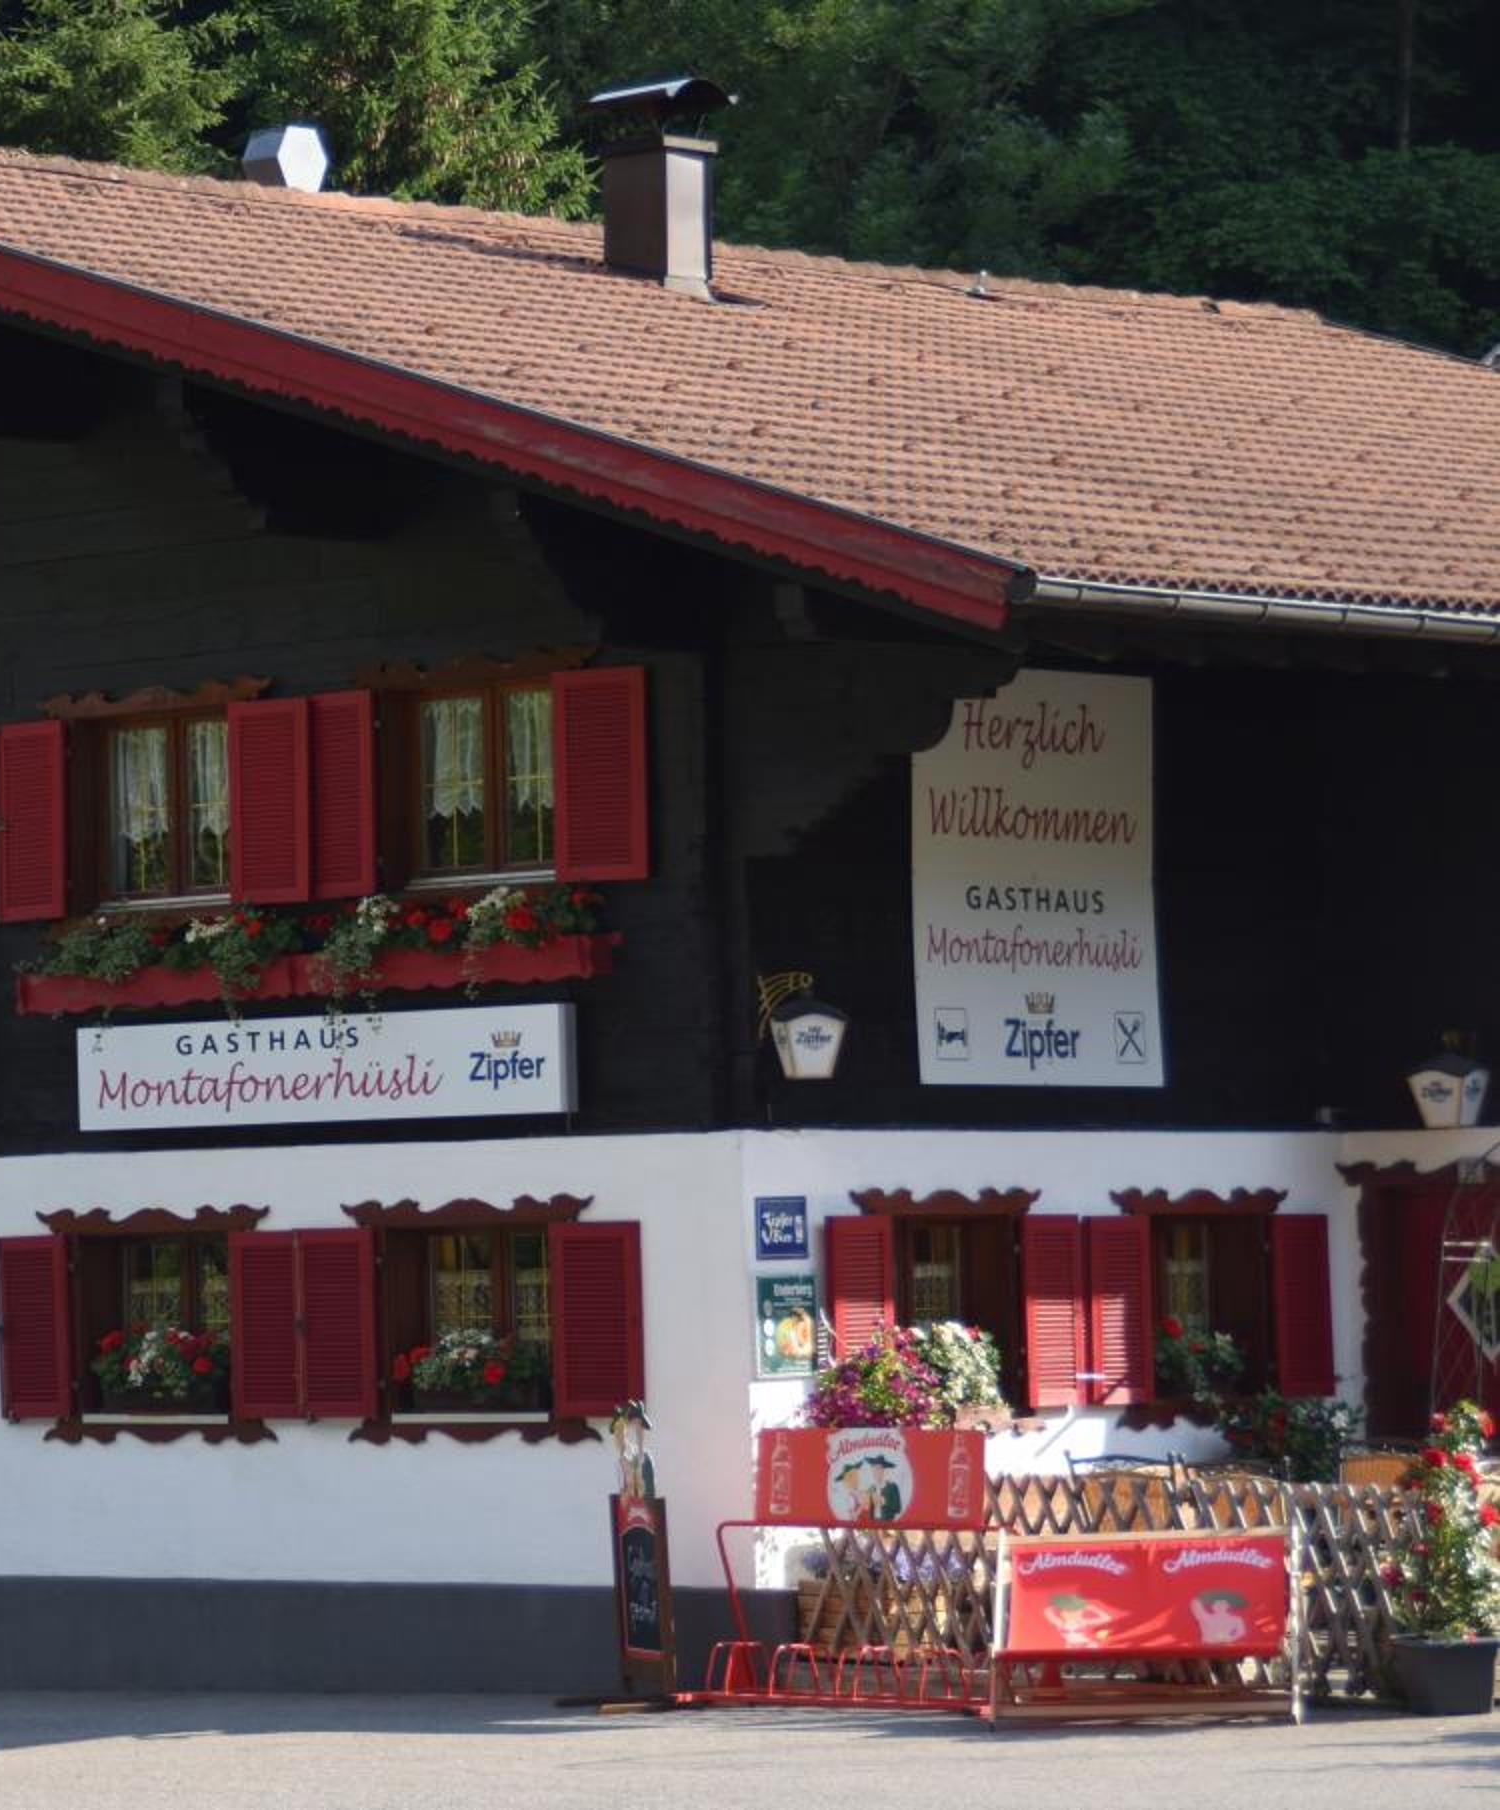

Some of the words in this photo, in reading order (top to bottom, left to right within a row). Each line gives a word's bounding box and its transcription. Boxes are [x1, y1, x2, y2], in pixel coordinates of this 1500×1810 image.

[963, 699, 1106, 770] Herzlich
[928, 786, 1138, 846] Willkommen
[965, 884, 1106, 916] GASTHAUS
[925, 924, 1143, 975] Montafonerhüsli
[176, 1026, 361, 1056] GASTHAUS
[1003, 1017, 1081, 1071] Zipfer
[98, 1055, 445, 1112] Montafonerhüsli
[468, 1050, 547, 1091] Zipfer
[1018, 1551, 1128, 1576] Almdudler
[1162, 1546, 1275, 1574] Almdudler
